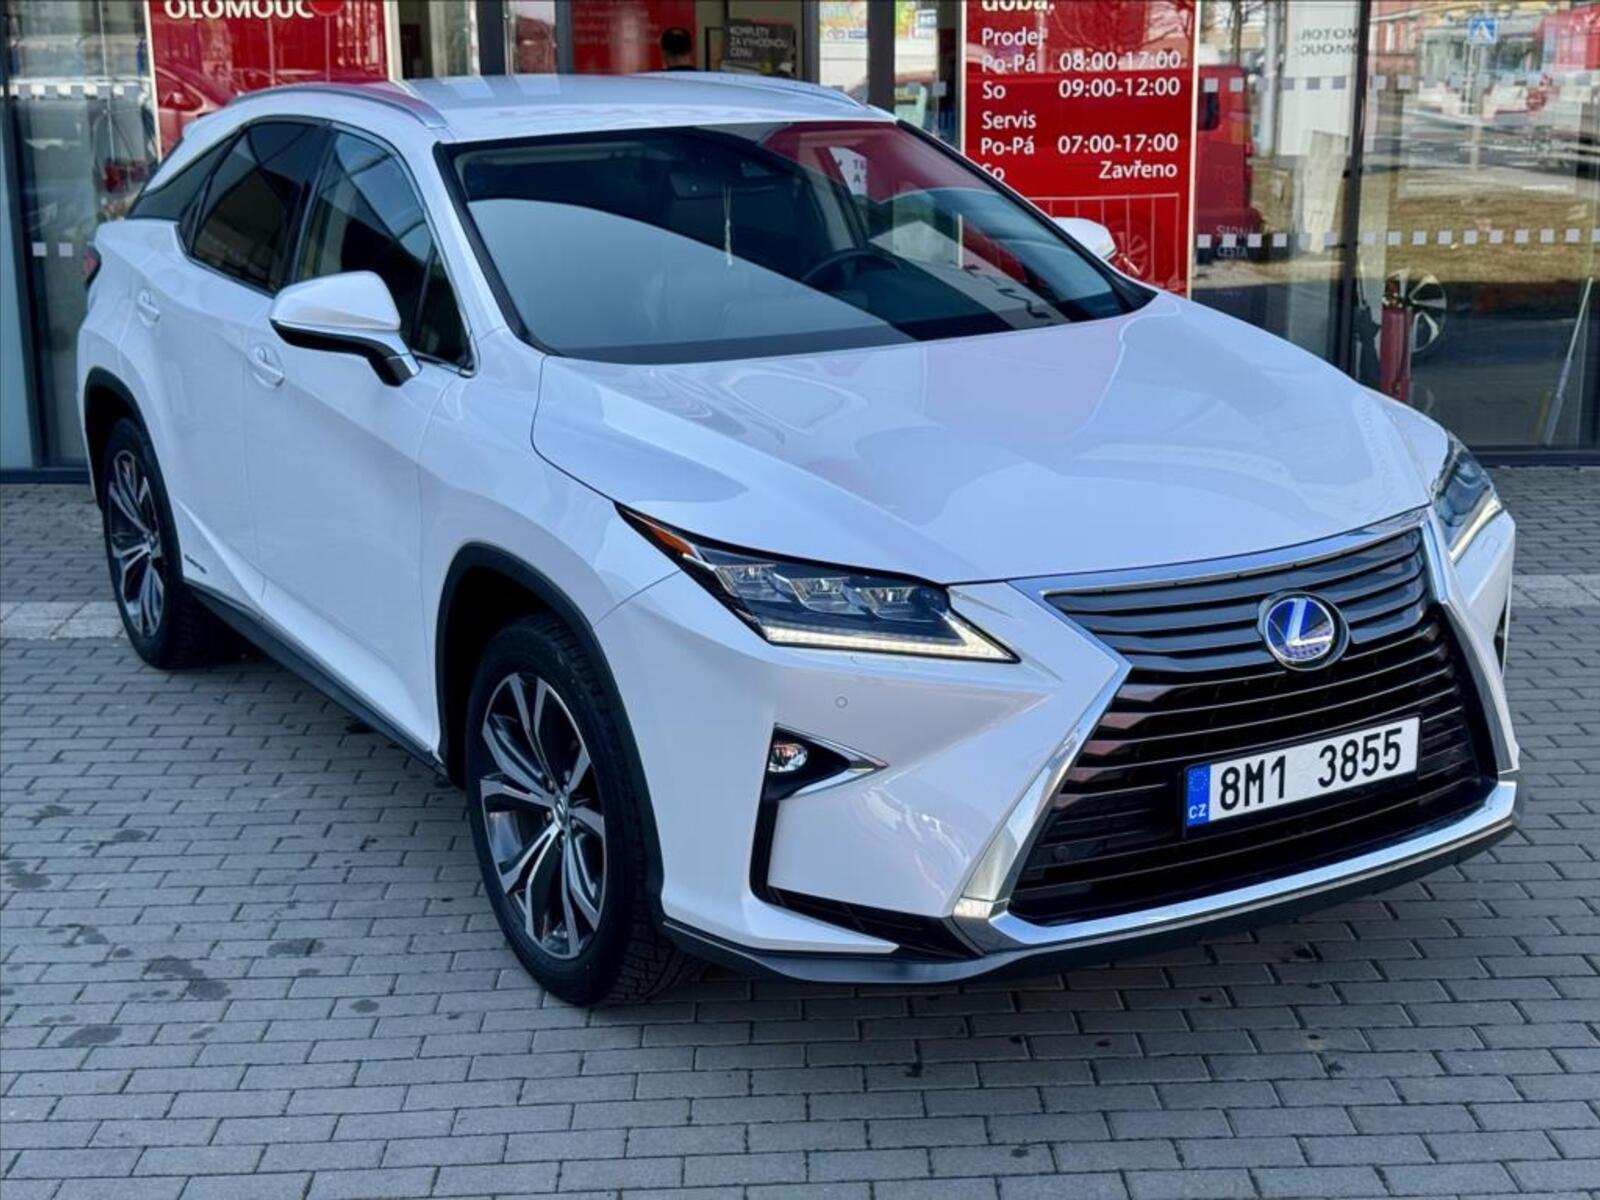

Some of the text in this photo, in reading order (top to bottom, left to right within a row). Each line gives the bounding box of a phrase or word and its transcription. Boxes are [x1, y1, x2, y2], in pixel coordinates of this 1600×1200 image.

[164, 0, 315, 19] OLOMOUC
[981, 50, 1181, 73] Po-Pá 08:00-17:00
[982, 77, 1181, 99] So 09:00-12:00
[981, 110, 1037, 130] Servis
[980, 133, 1179, 156] Po-Pá 07:00-17:00
[1099, 159, 1178, 180] Zavřeno
[1220, 727, 1402, 811] 8M1 3855
[1188, 803, 1207, 820] CZ
